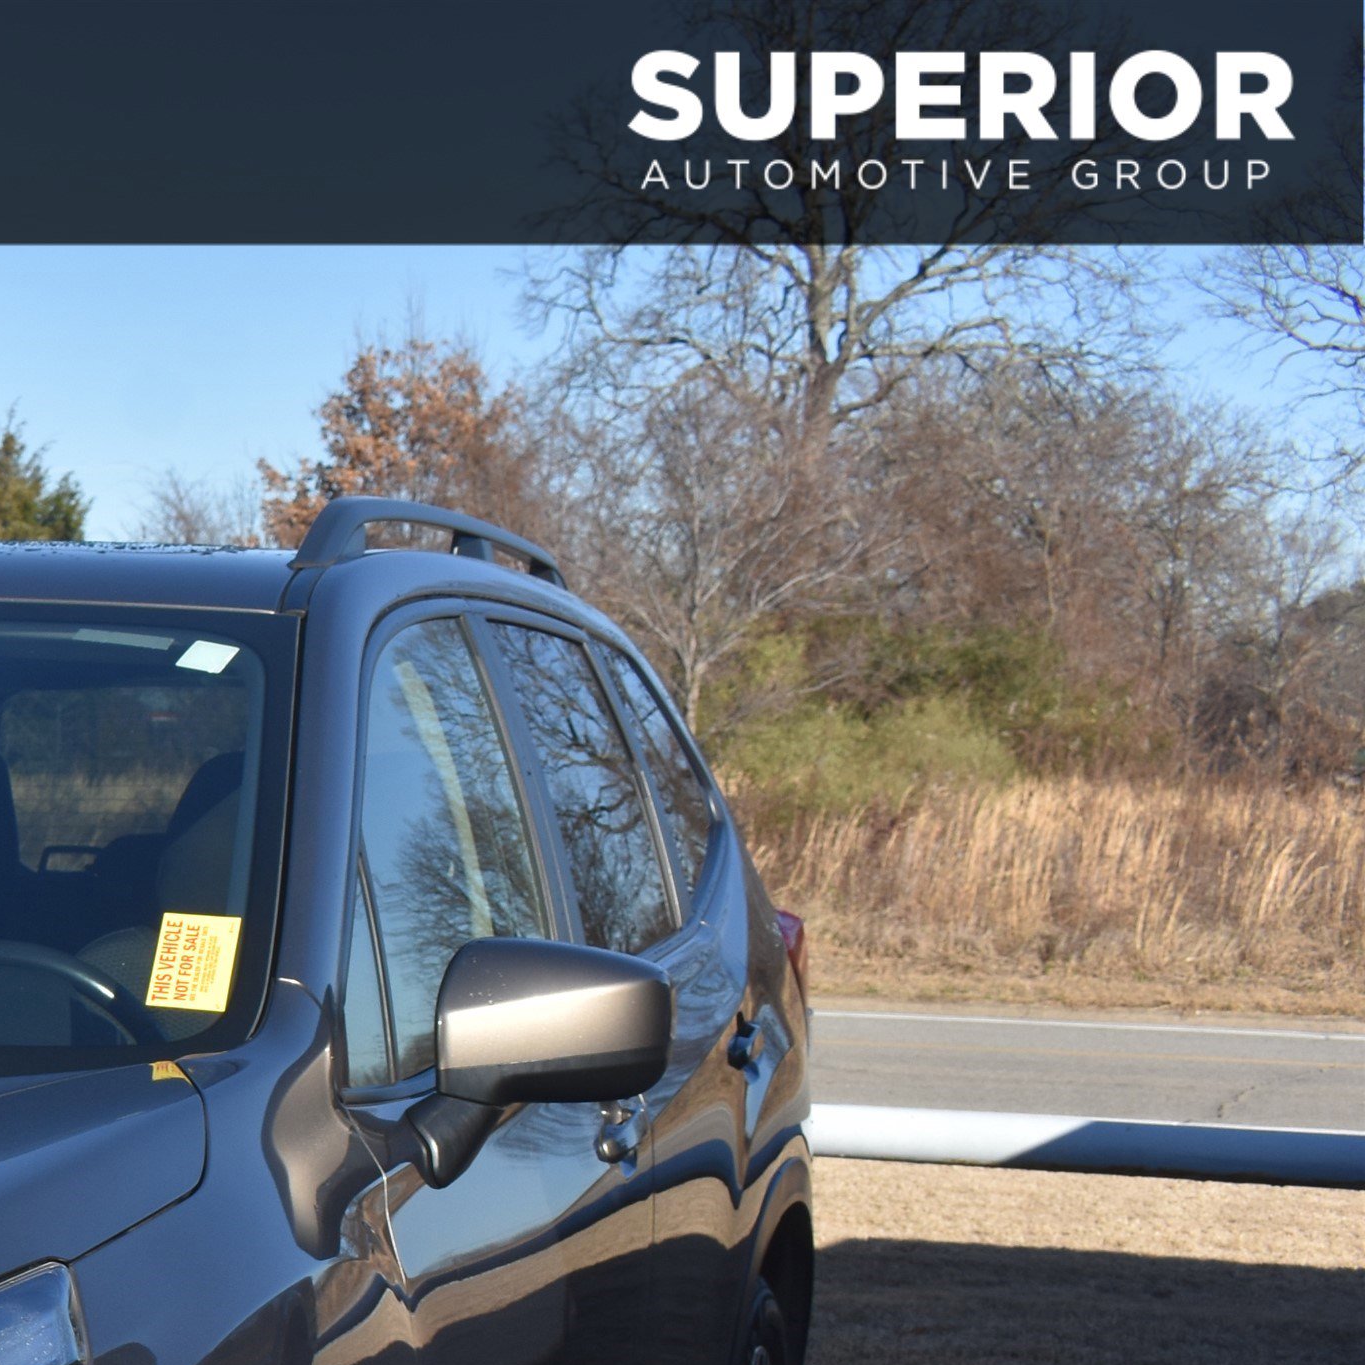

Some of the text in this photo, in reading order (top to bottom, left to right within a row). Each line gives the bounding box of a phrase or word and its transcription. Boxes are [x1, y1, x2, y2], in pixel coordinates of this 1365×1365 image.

[183, 924, 200, 951] SALE
[151, 920, 183, 1001] THIS VEHICLE
[178, 955, 195, 977] FOR
[173, 980, 190, 1001] NOT
